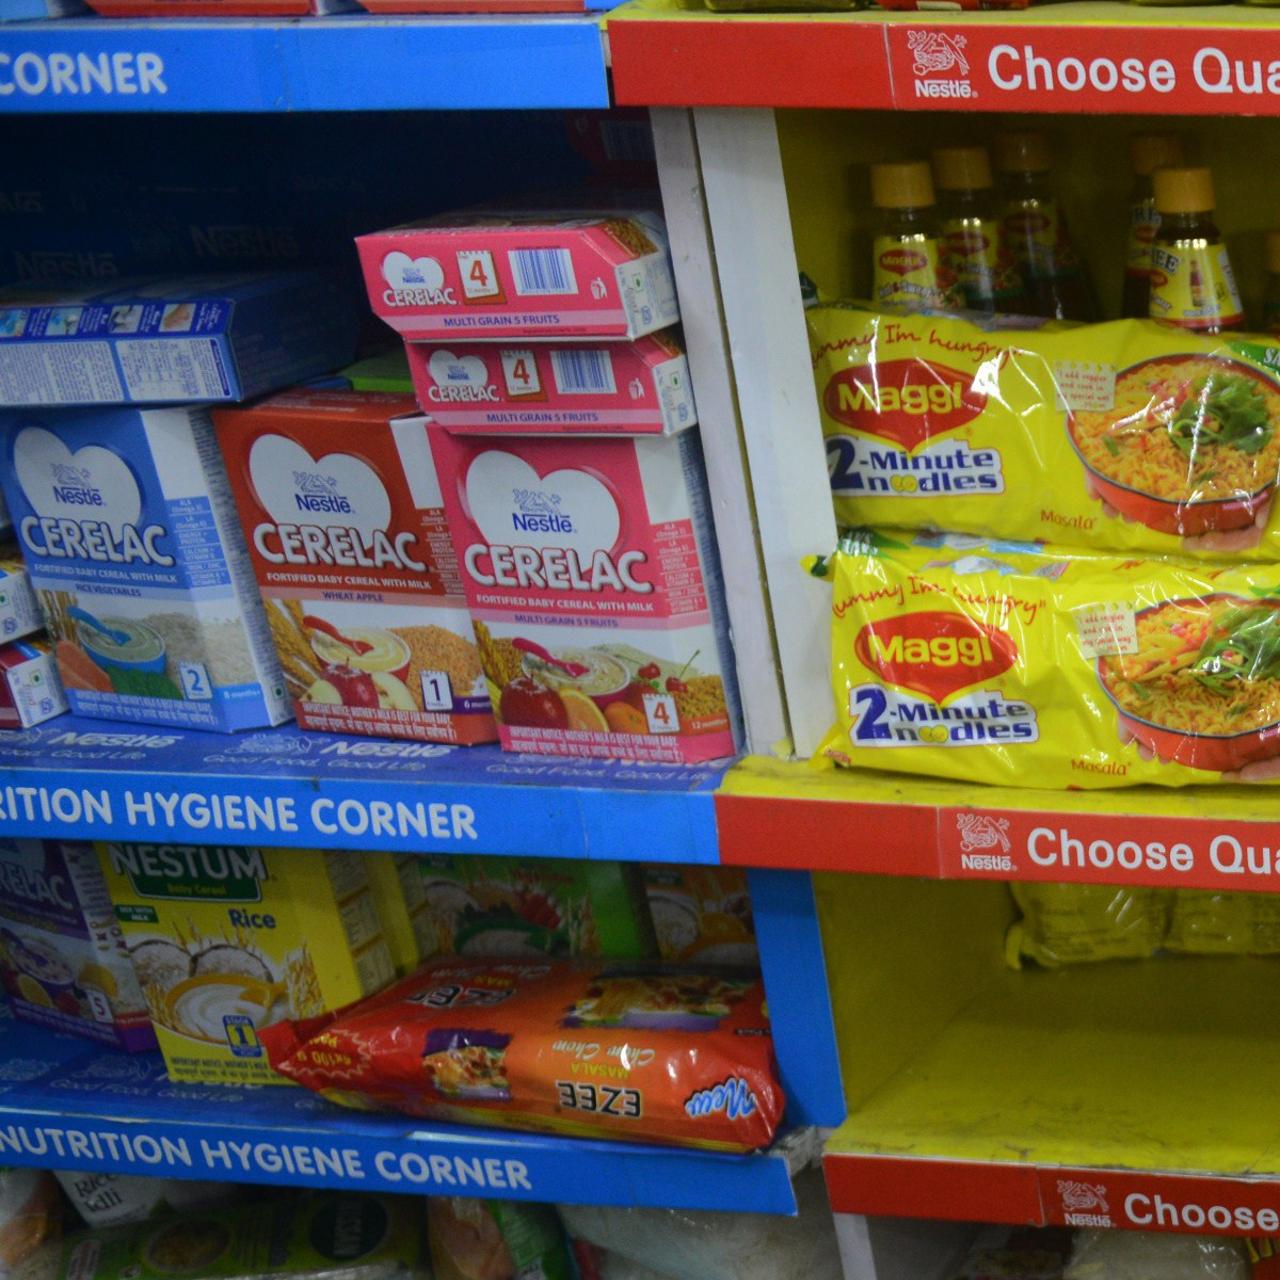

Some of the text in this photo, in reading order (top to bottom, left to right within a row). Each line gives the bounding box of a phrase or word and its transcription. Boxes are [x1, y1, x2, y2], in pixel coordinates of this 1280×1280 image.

[988, 44, 1177, 92] Choose
[469, 259, 488, 287] 4
[382, 287, 457, 307] CERELAC
[443, 314, 560, 328] MULTI GRAIN 5 FRUITS
[512, 358, 530, 386] 4
[427, 384, 498, 403] CERELAC
[836, 380, 963, 416] Maggi
[486, 412, 599, 424] MULTI GRAIN 5 FRUITS
[1040, 509, 1097, 530] Masala
[19, 515, 177, 570] CERELAC
[253, 522, 428, 574] CERELAC
[266, 571, 432, 591] FORTIFIED BABY CEREAL WITH MILK
[463, 543, 655, 595] CERELAC
[76, 583, 142, 598] RICE VEGETABLES
[322, 590, 385, 604] WHEAT APPLE
[476, 593, 654, 613] FORTIFIED BABY CEREAL WITH MILK
[514, 613, 619, 628] MULTI GRAIN FRUITS
[866, 631, 995, 668] Maggi
[186, 667, 203, 693] 2
[430, 679, 440, 701] 1
[654, 702, 671, 725] 4
[852, 688, 1029, 742] 2-Minute
[1070, 757, 1134, 778] Masala
[0, 786, 478, 841] ITION HYGIENE CORNER
[108, 843, 269, 883] NESTUM
[1026, 827, 1195, 873] Choose
[227, 907, 278, 932] Rice
[236, 1026, 250, 1045] 1
[570, 1062, 631, 1079] MASALA
[555, 1080, 643, 1119] EZEE
[684, 1077, 757, 1121] New
[200, 1137, 365, 1178] HYGIENE
[374, 1151, 532, 1191] CORNER
[1123, 1192, 1280, 1232] Choose
